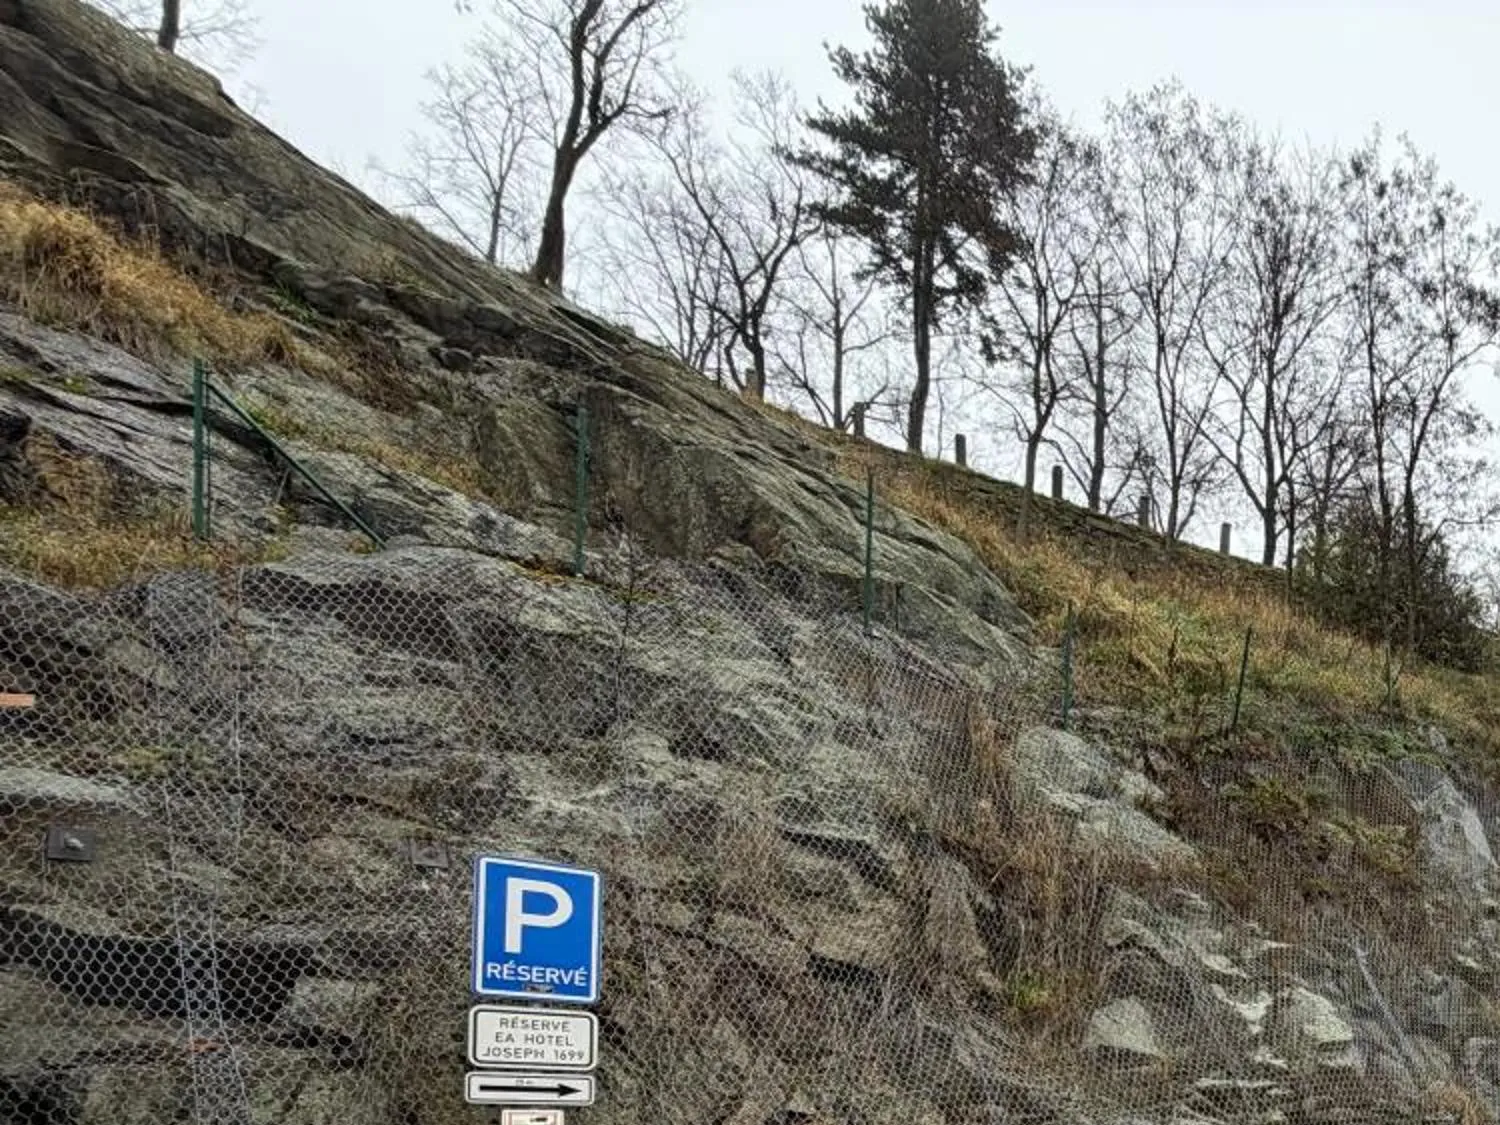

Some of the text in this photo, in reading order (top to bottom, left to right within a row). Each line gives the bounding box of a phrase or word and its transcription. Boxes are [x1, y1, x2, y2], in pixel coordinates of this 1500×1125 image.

[504, 876, 574, 954] P
[486, 960, 589, 987] RÉSERVÉ
[495, 1032, 515, 1043] EA
[482, 1046, 585, 1061] JOSEPH 1699
